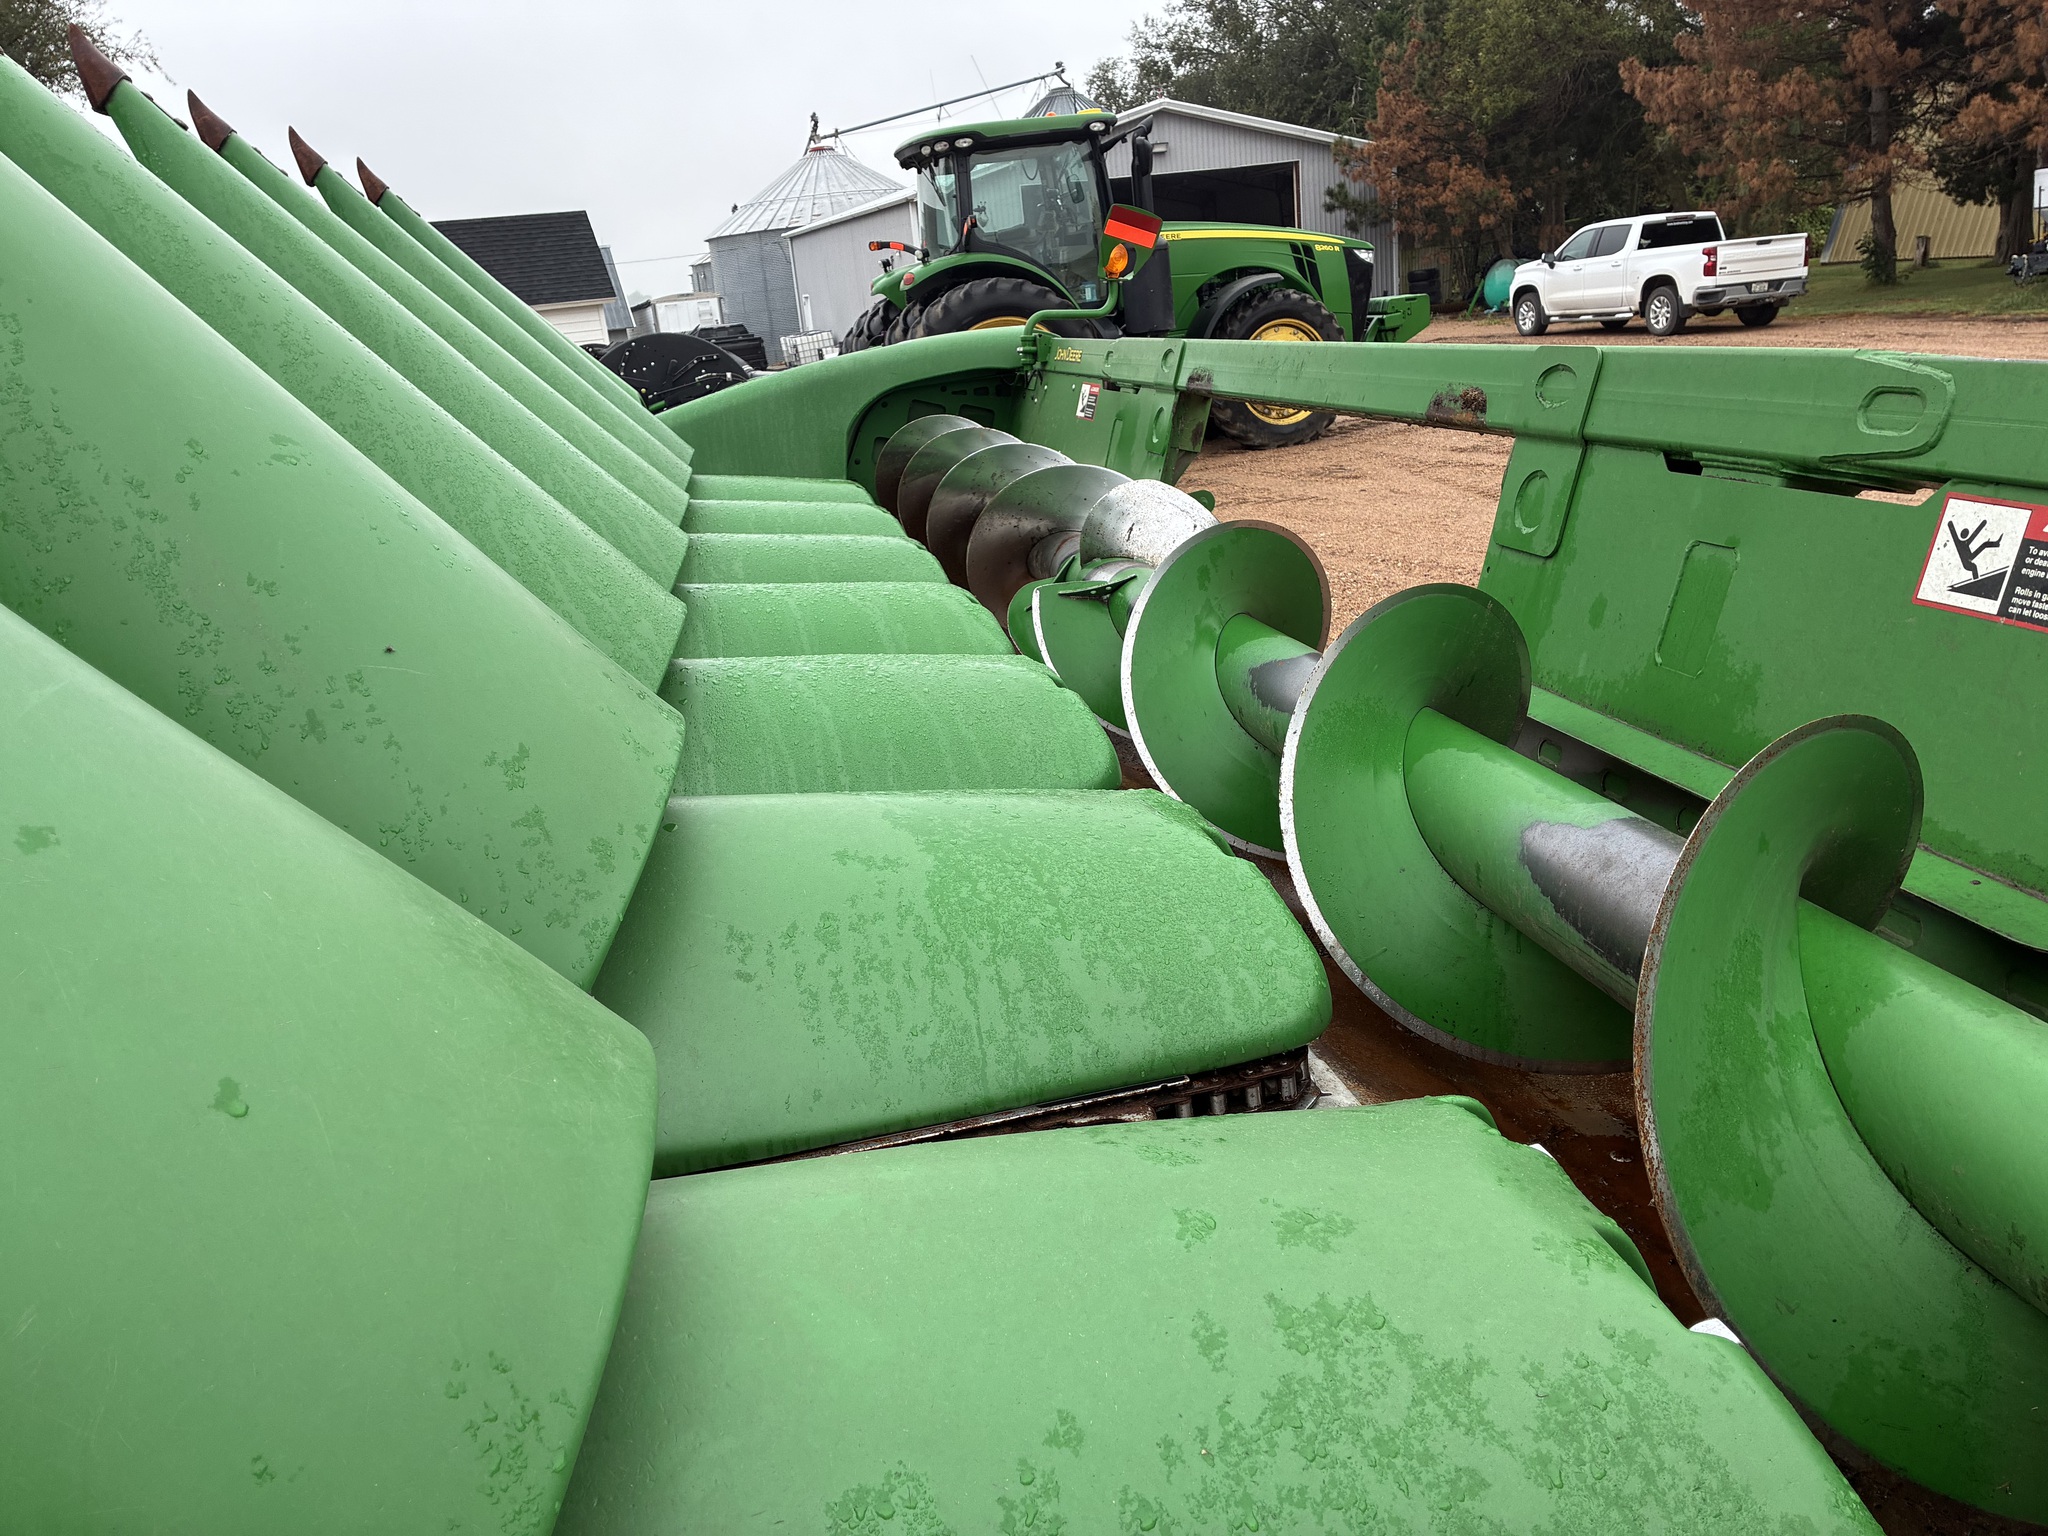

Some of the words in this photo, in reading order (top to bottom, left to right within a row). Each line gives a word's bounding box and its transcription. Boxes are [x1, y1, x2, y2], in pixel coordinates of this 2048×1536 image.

[1066, 346, 1082, 362] DEERE
[2029, 546, 2038, 555] To
[2025, 556, 2034, 565] or
[2021, 567, 2045, 578] engine
[2014, 586, 2033, 597] Rolls
[2034, 590, 2041, 599] in
[2011, 597, 2031, 606] move
[2008, 606, 2022, 615] can
[2022, 607, 2032, 617] let
[2032, 609, 2048, 621] loos
